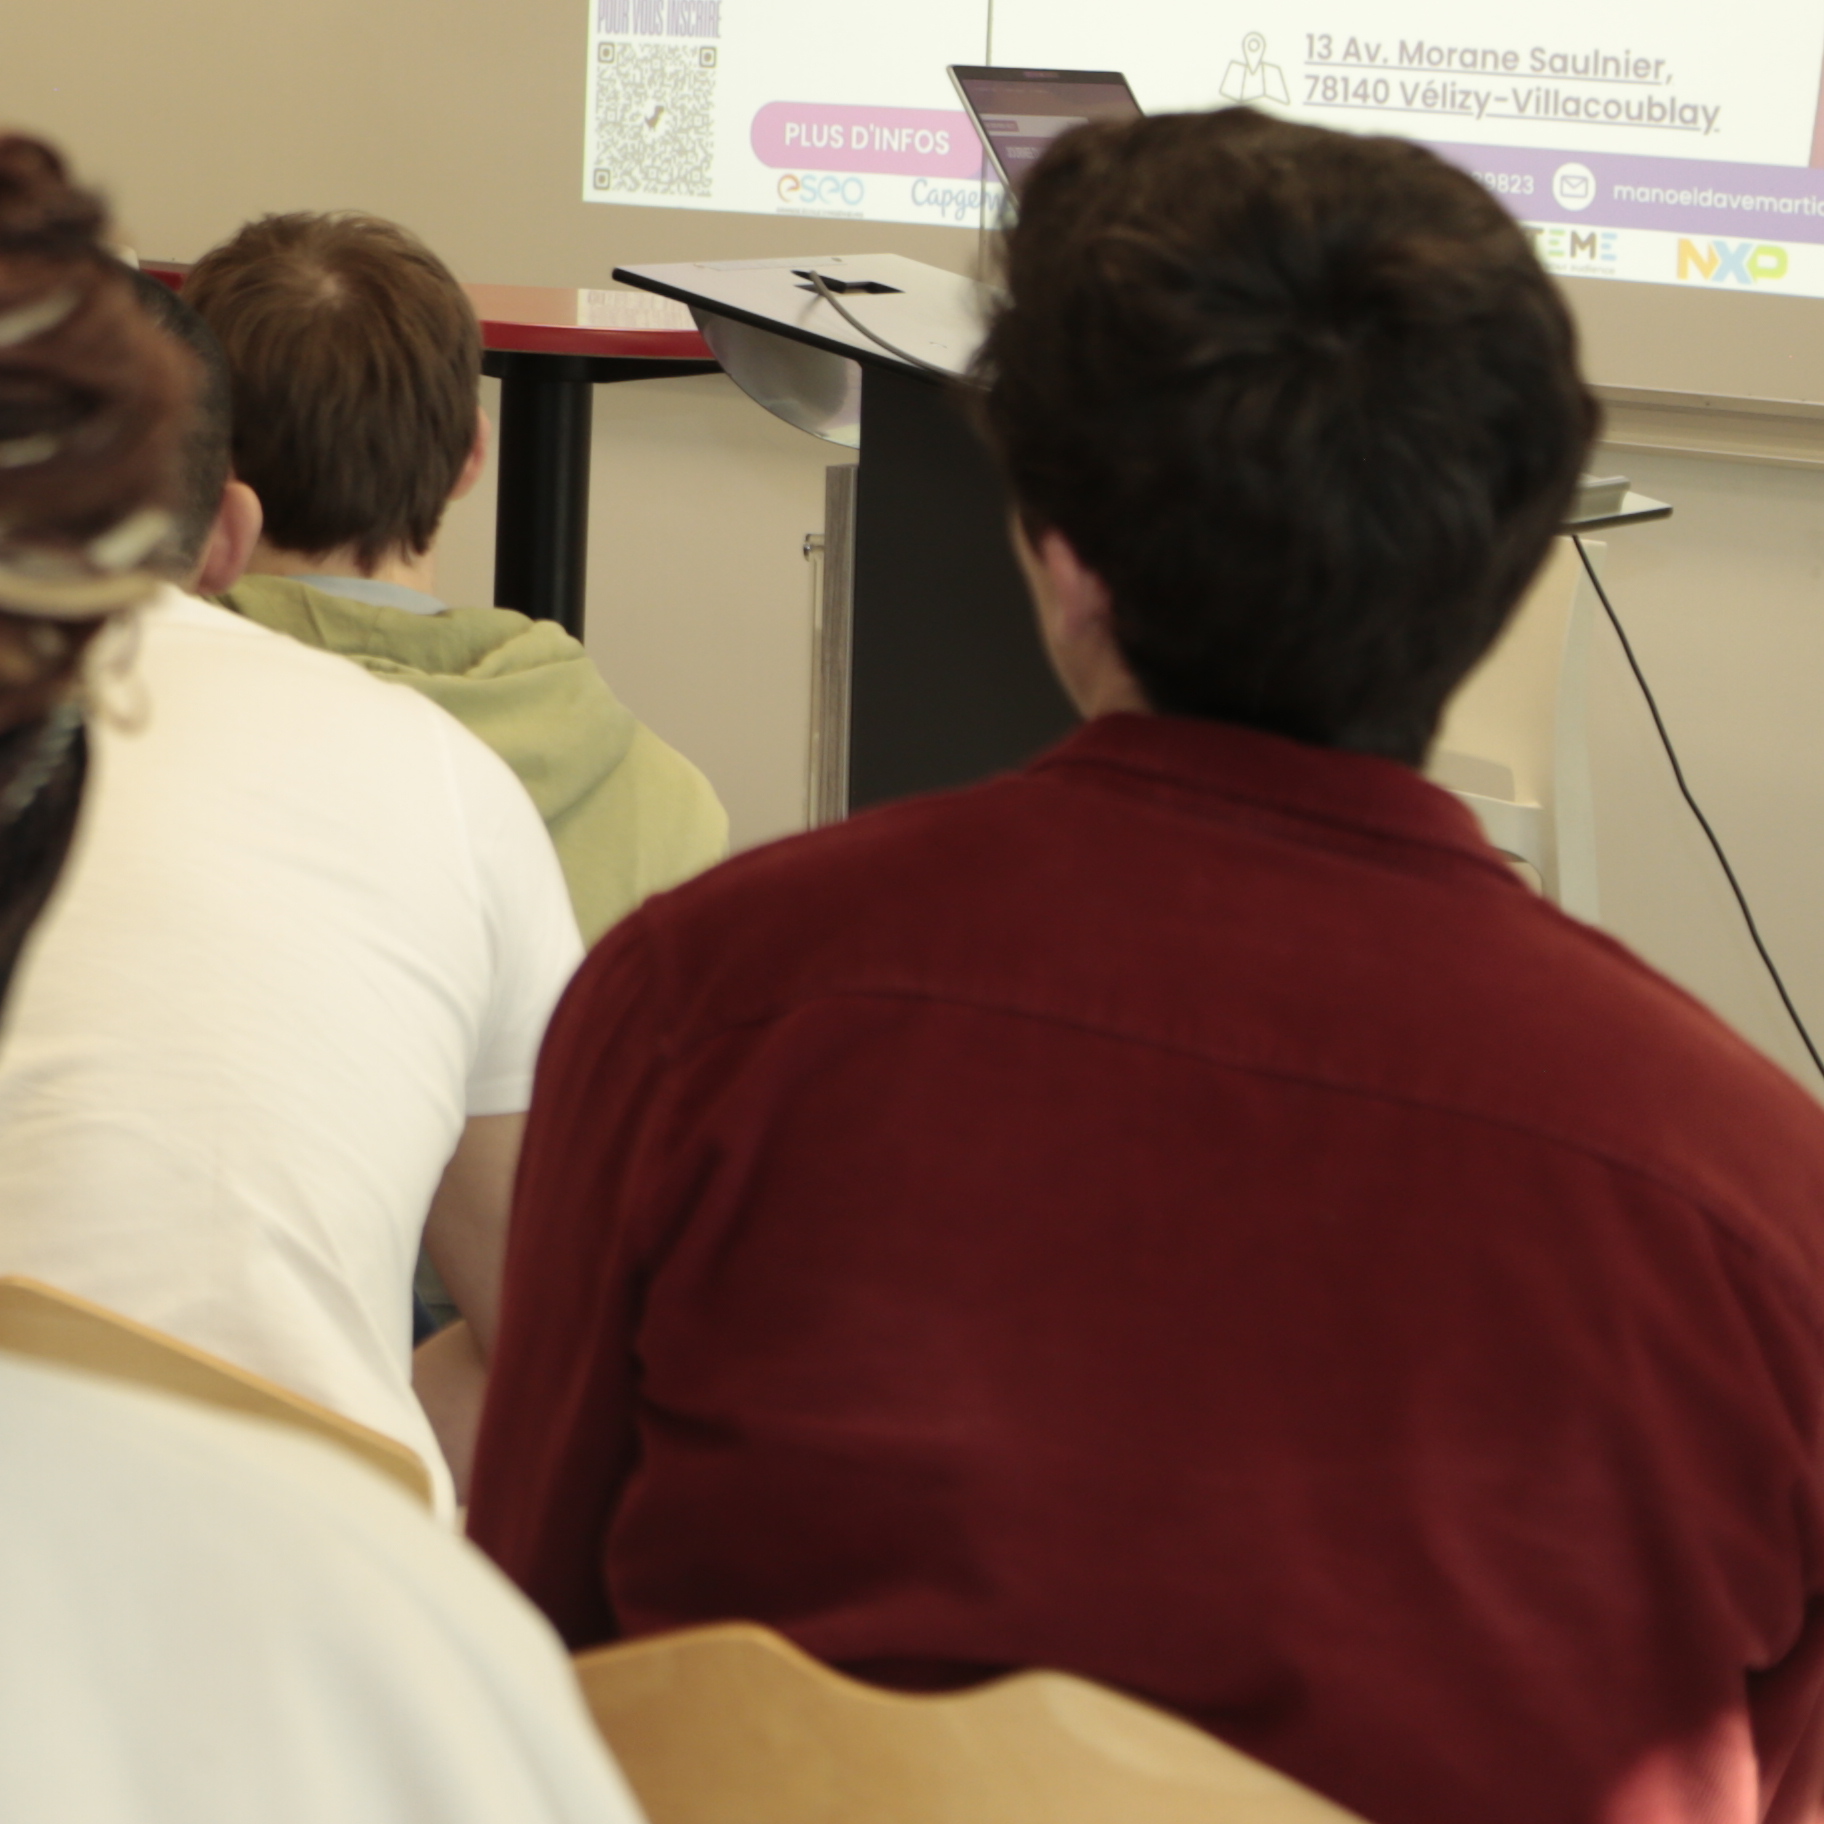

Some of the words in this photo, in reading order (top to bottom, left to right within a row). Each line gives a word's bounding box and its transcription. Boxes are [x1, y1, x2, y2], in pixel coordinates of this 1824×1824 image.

[1305, 33, 1333, 61] 13
[1342, 36, 1389, 65] Av.
[1399, 40, 1520, 71] Morane
[1530, 47, 1674, 86] Saulnier,
[1304, 74, 1389, 104] 78140
[1399, 80, 1721, 134] Vélizy-Villacoublay
[784, 122, 844, 150] PLUS
[851, 123, 950, 155] D'INFOS
[776, 174, 865, 206] eseo
[1676, 237, 1790, 285] NXP
